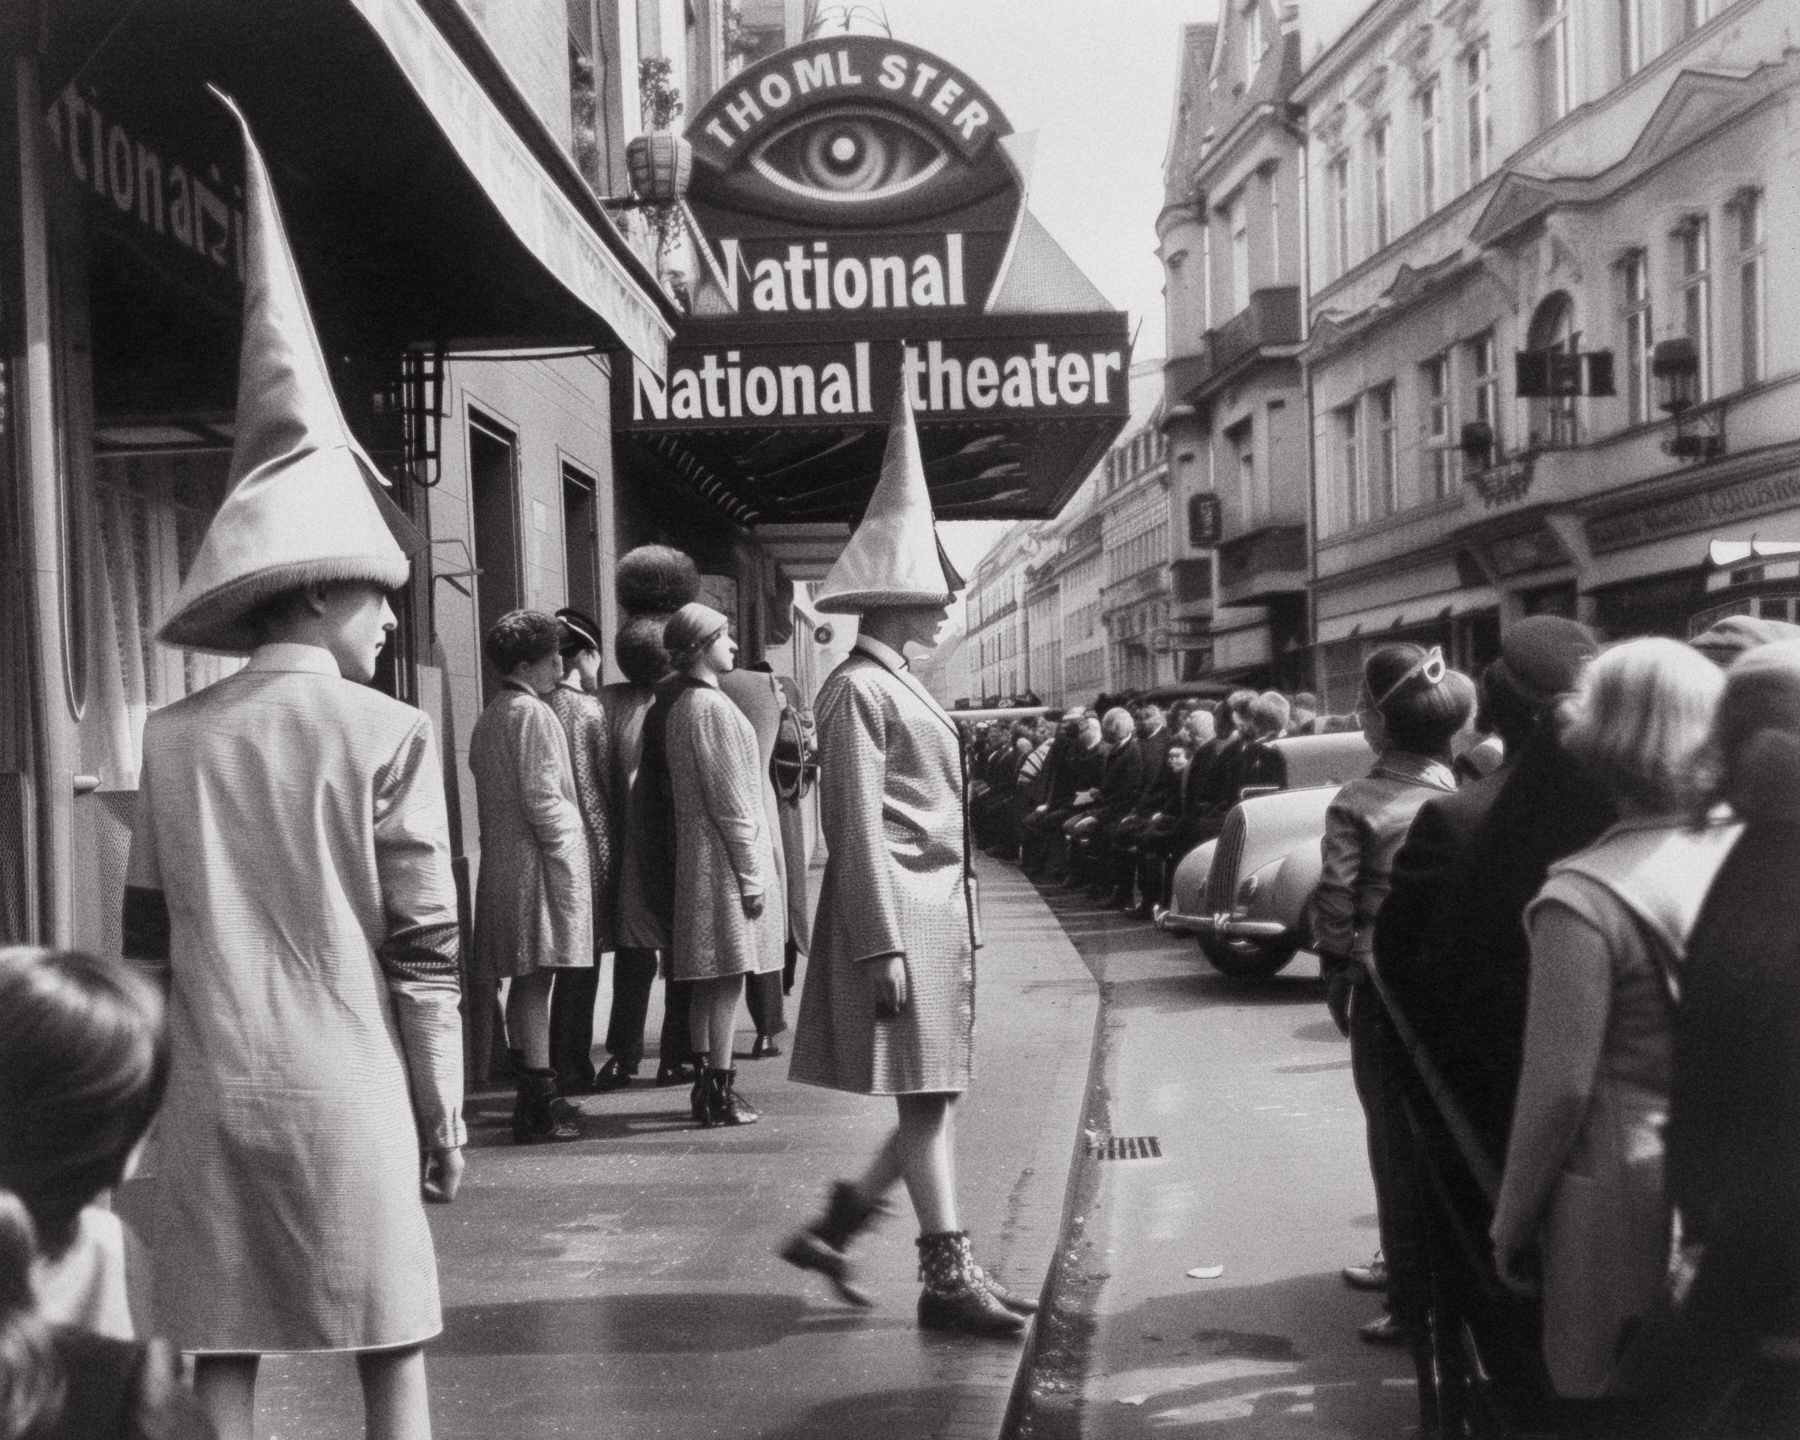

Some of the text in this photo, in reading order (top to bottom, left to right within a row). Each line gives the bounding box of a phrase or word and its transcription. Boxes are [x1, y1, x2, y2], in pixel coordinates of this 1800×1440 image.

[705, 50, 990, 148] THOML STER
[632, 340, 1121, 421] National theater
